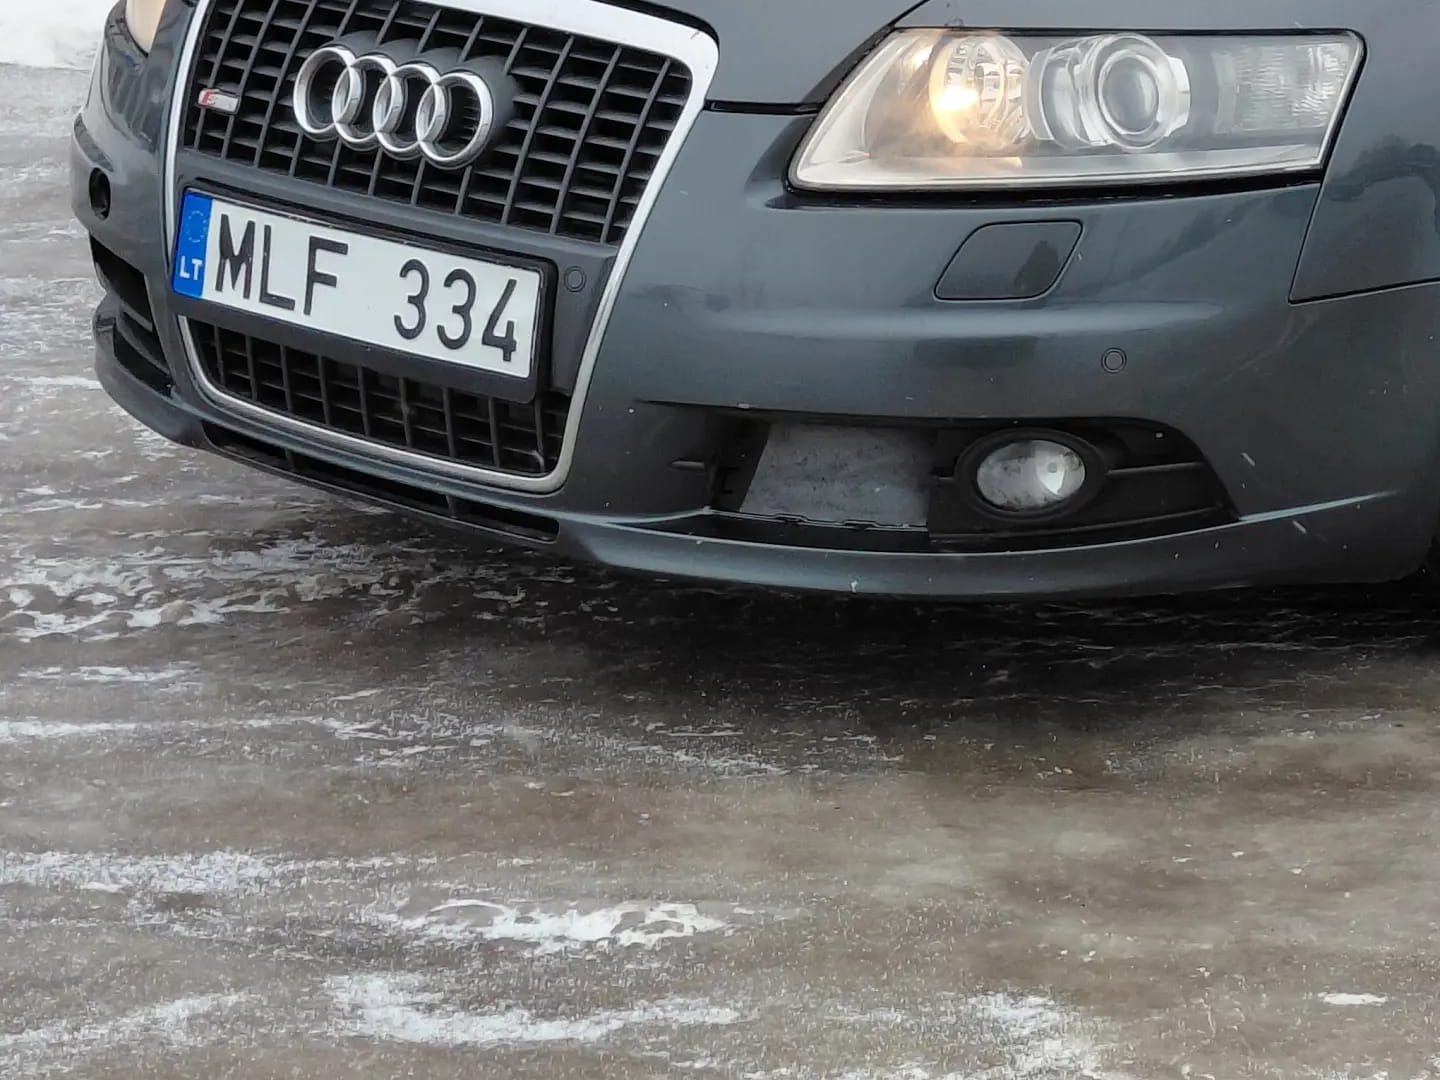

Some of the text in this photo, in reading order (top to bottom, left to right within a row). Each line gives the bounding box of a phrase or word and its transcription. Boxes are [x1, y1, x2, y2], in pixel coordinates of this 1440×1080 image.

[179, 255, 203, 281] LT
[215, 213, 518, 362] MLF 334
